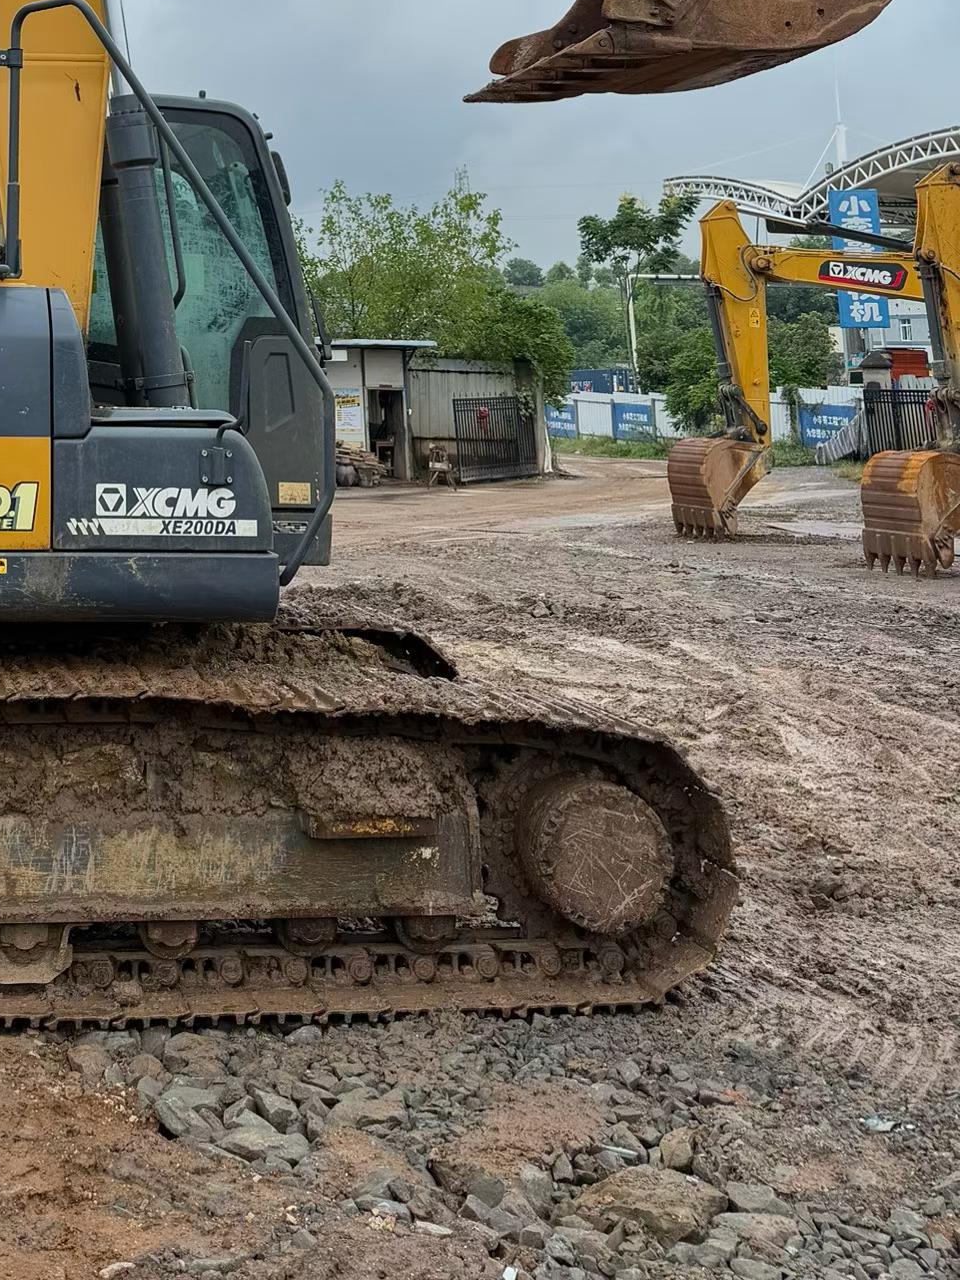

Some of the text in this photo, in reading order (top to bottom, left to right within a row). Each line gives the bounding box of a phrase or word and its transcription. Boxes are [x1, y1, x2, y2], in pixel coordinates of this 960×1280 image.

[842, 265, 893, 285] XCMG
[127, 486, 237, 518] XCMG
[159, 519, 238, 536] XE200DA
